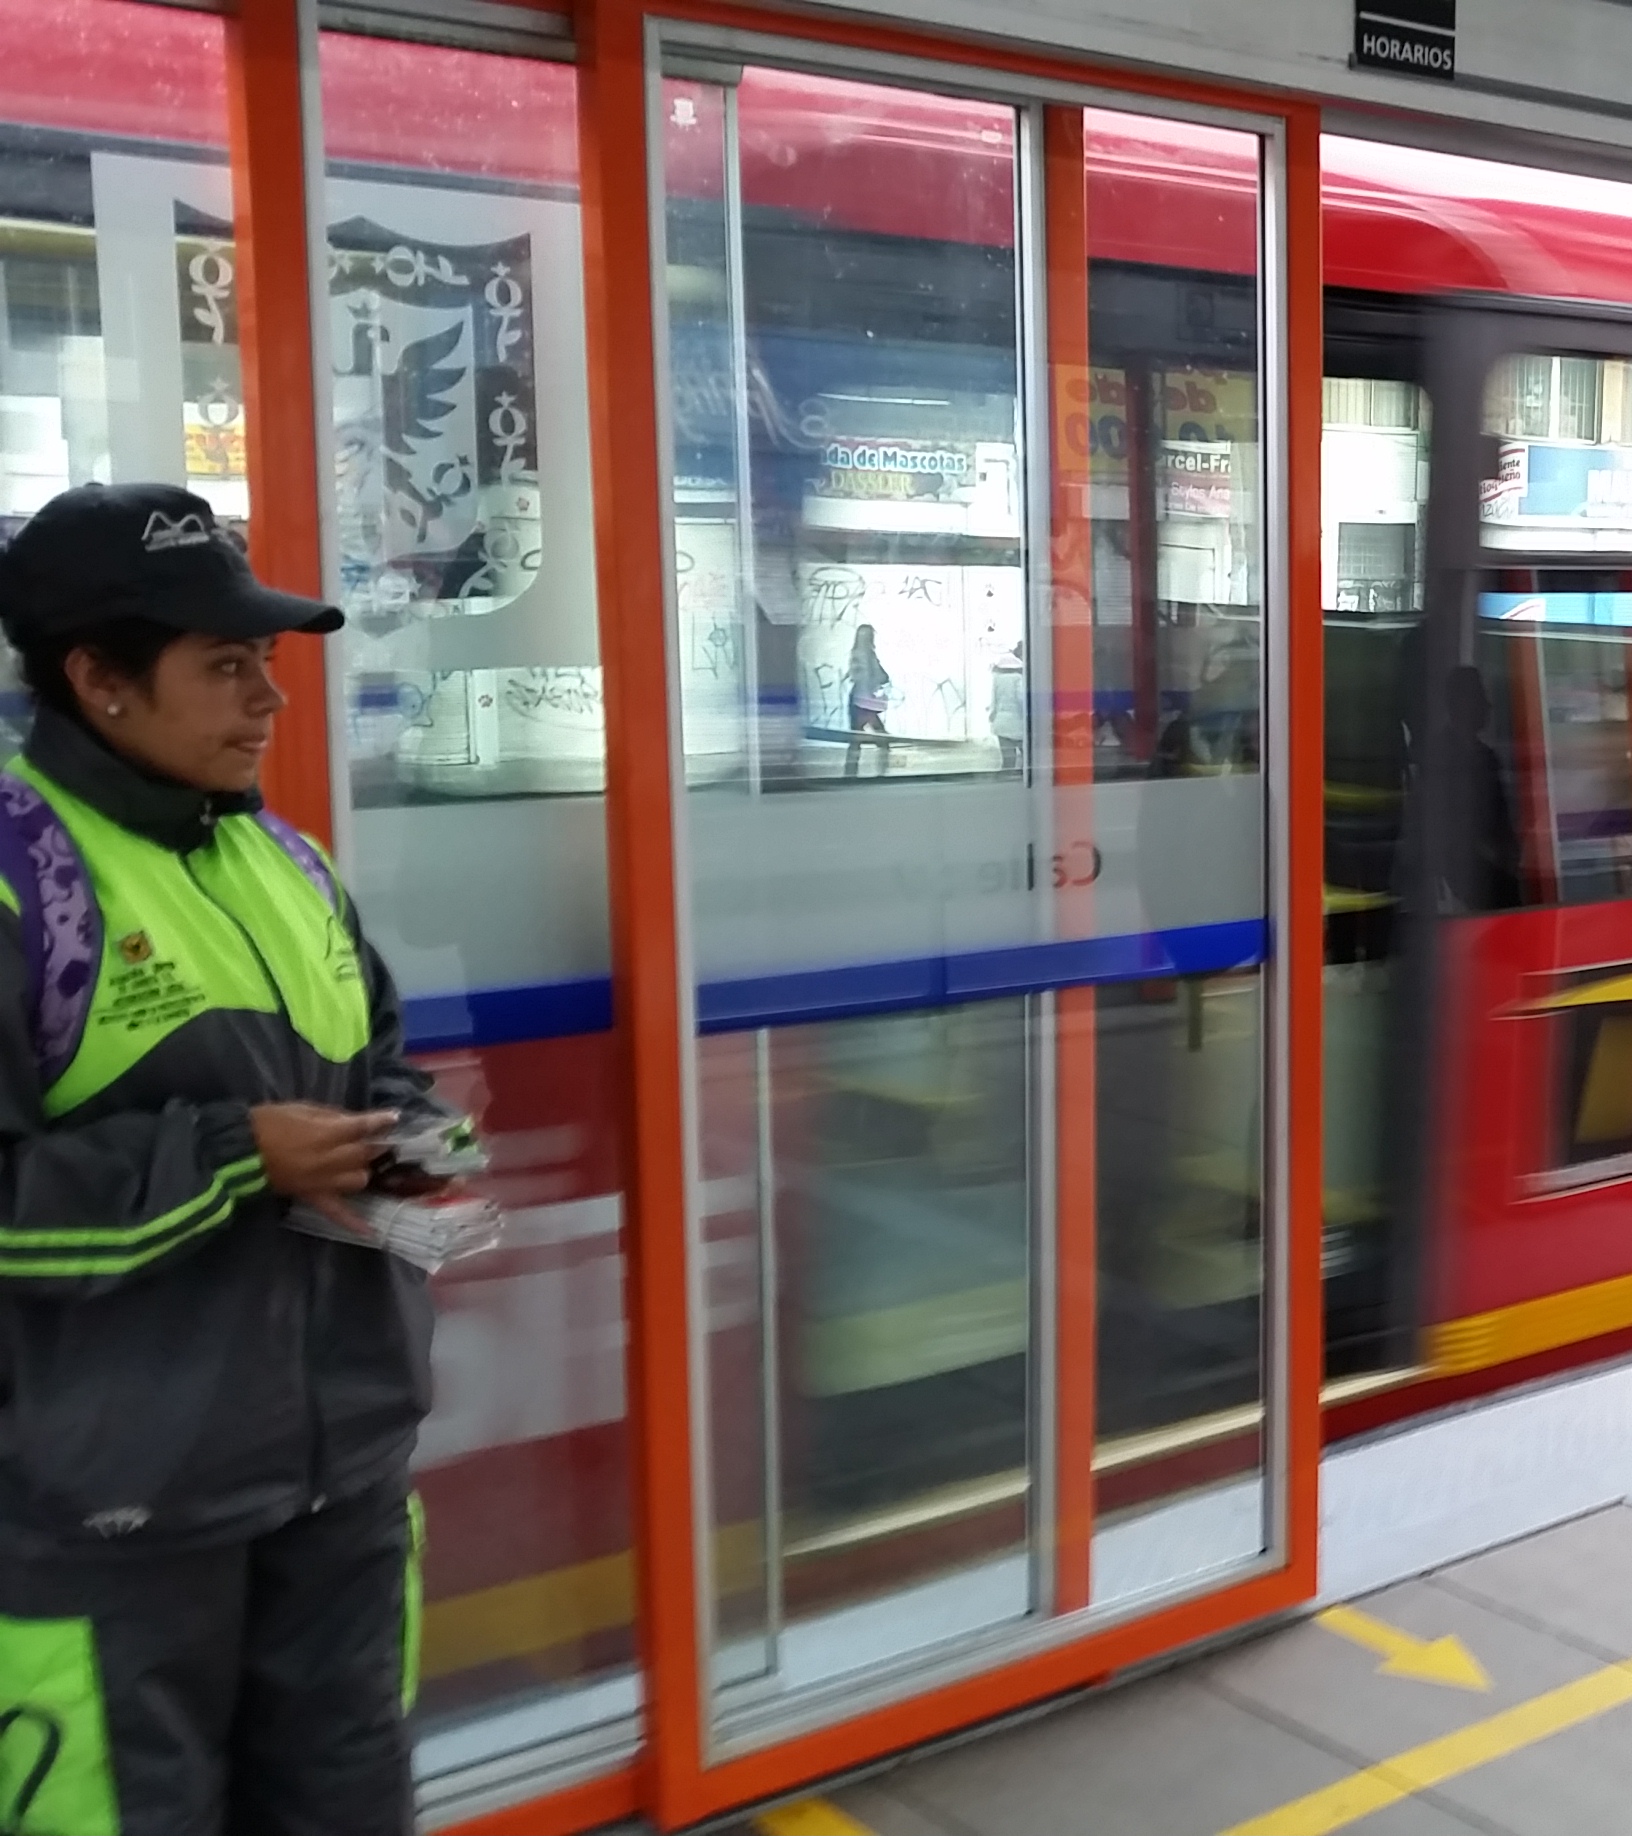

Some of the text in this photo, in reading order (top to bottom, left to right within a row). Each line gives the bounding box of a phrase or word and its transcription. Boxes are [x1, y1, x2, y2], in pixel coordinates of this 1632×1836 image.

[1363, 32, 1452, 71] HORARIOS
[855, 446, 877, 468] de
[881, 450, 966, 473] Mascotas
